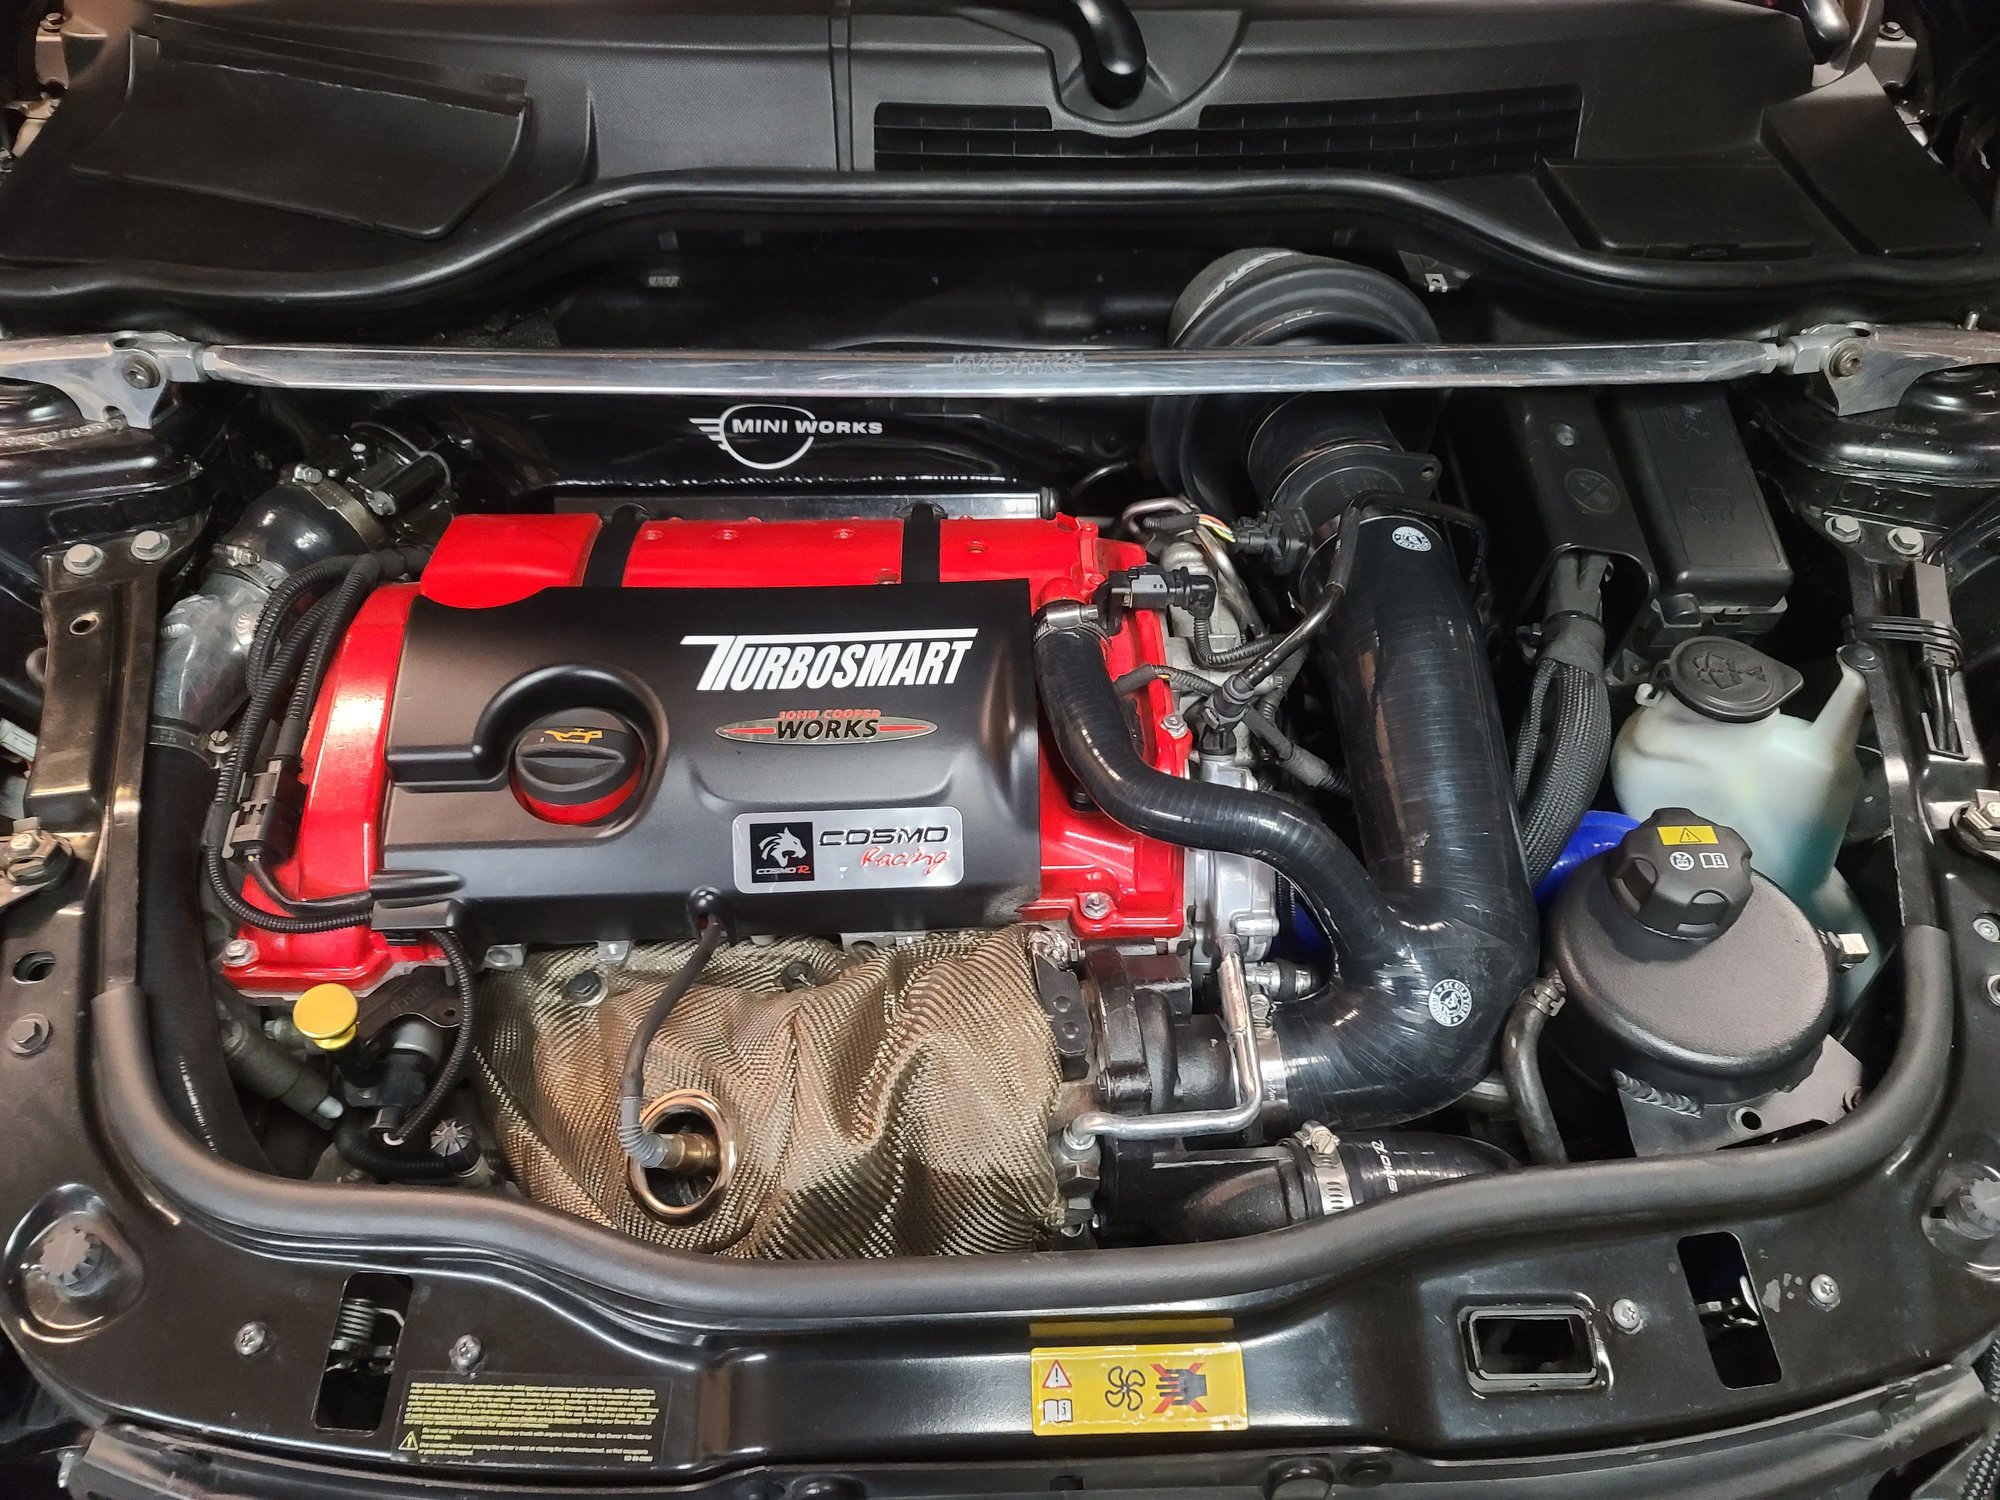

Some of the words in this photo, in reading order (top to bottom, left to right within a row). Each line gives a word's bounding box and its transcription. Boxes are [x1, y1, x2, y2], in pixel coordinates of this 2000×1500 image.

[953, 356, 1087, 376] WORKS
[731, 418, 789, 434] MINI
[795, 419, 884, 435] WORKS
[680, 627, 979, 692] TURBOSMART
[778, 710, 820, 721] JOHN
[822, 708, 881, 720] COOPER
[777, 719, 879, 740] WORKS
[818, 825, 950, 846] COSMO
[860, 845, 950, 877] Racing
